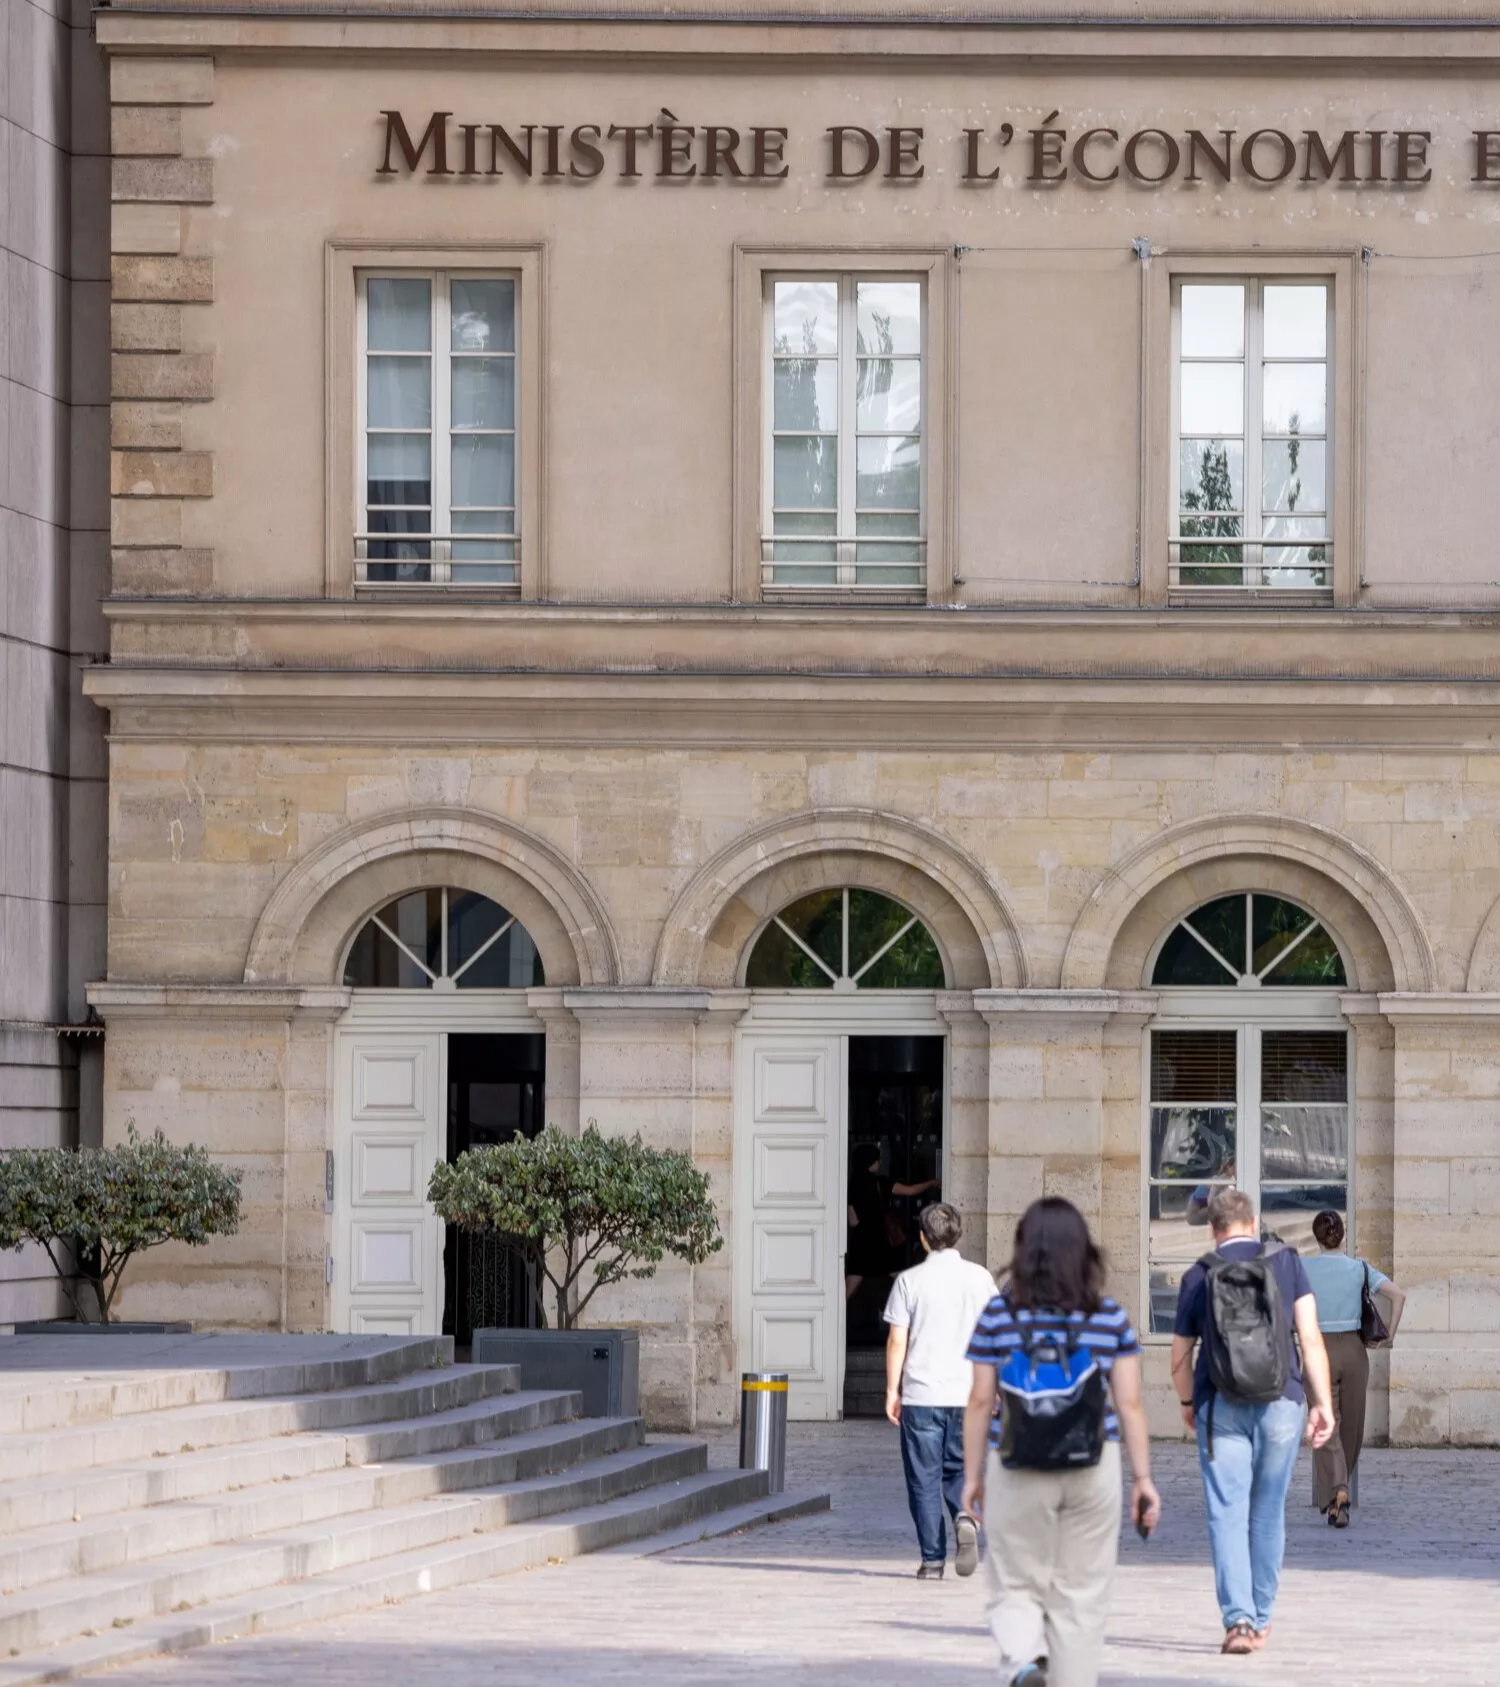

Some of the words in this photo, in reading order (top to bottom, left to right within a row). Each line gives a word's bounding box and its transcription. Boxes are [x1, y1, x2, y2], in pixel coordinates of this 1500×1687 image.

[375, 107, 790, 179] MINISTÈRE
[826, 126, 925, 179] DE
[962, 110, 1432, 182] L'ÉCONOMIE
